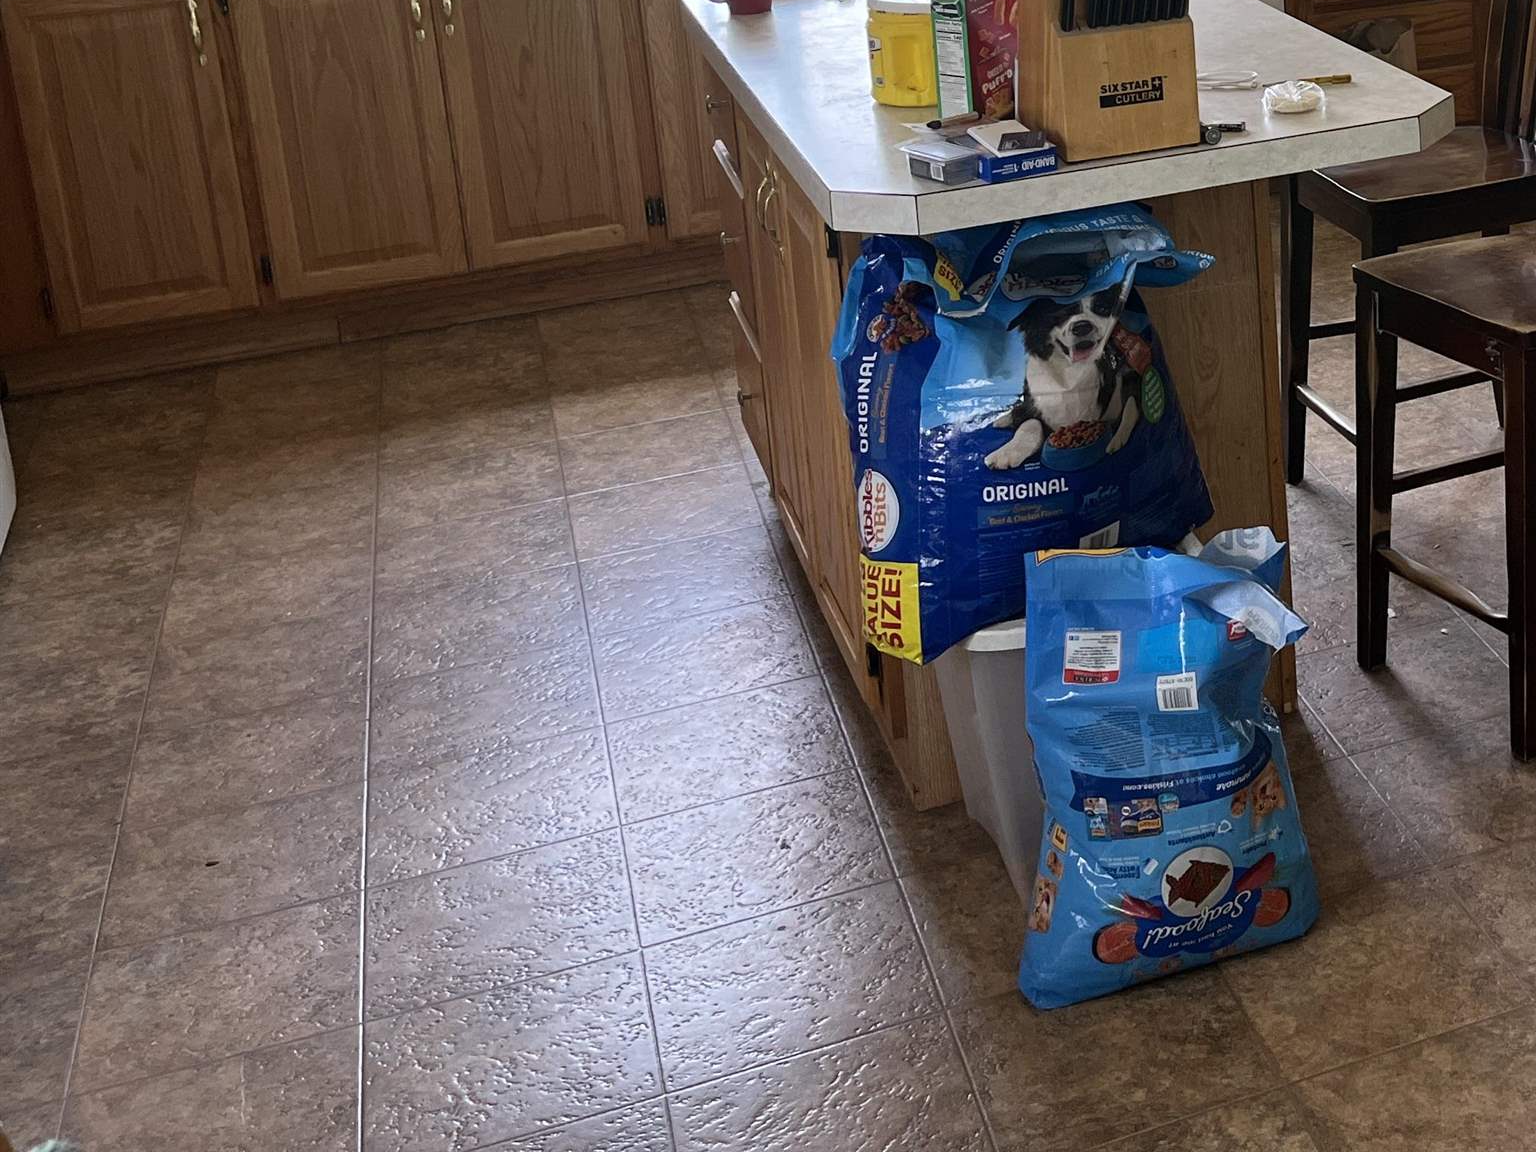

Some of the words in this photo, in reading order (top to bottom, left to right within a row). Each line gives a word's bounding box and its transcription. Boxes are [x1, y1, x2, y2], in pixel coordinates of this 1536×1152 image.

[1100, 82, 1119, 94] SIX
[1121, 79, 1149, 92] STAR
[1116, 90, 1162, 104] CUTLERY
[1090, 214, 1129, 229] TASTE
[857, 351, 878, 453] ORIGINAL
[983, 477, 1069, 502] ORIGINAL
[862, 469, 873, 551] Kibbles
[1143, 890, 1252, 949] Seafood!
